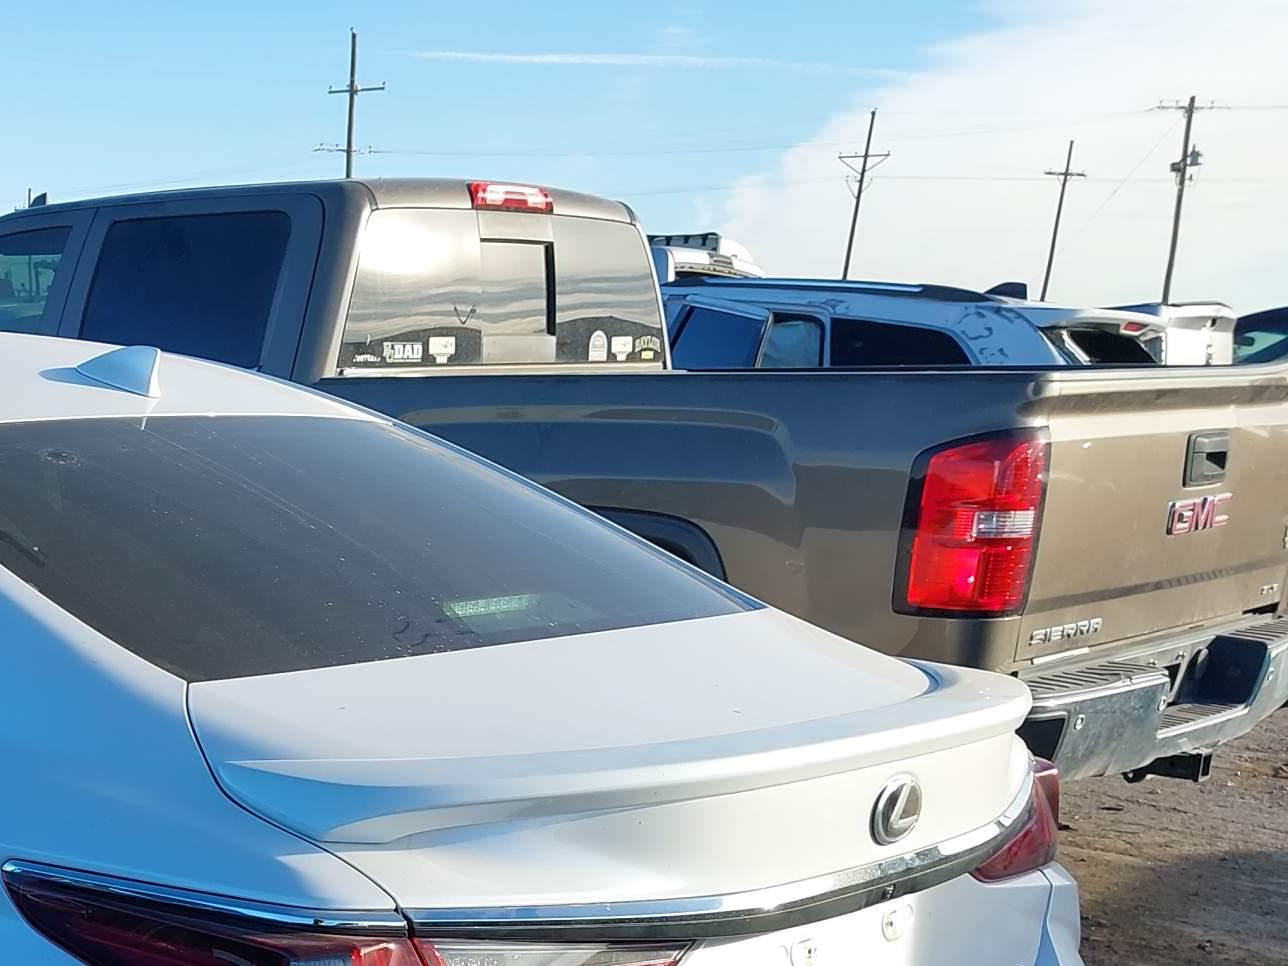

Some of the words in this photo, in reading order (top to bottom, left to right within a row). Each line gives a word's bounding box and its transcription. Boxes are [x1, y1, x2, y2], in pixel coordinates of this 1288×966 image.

[394, 344, 423, 359] DAD
[1166, 492, 1233, 535] GMC
[1029, 617, 1103, 646] SIERRA
